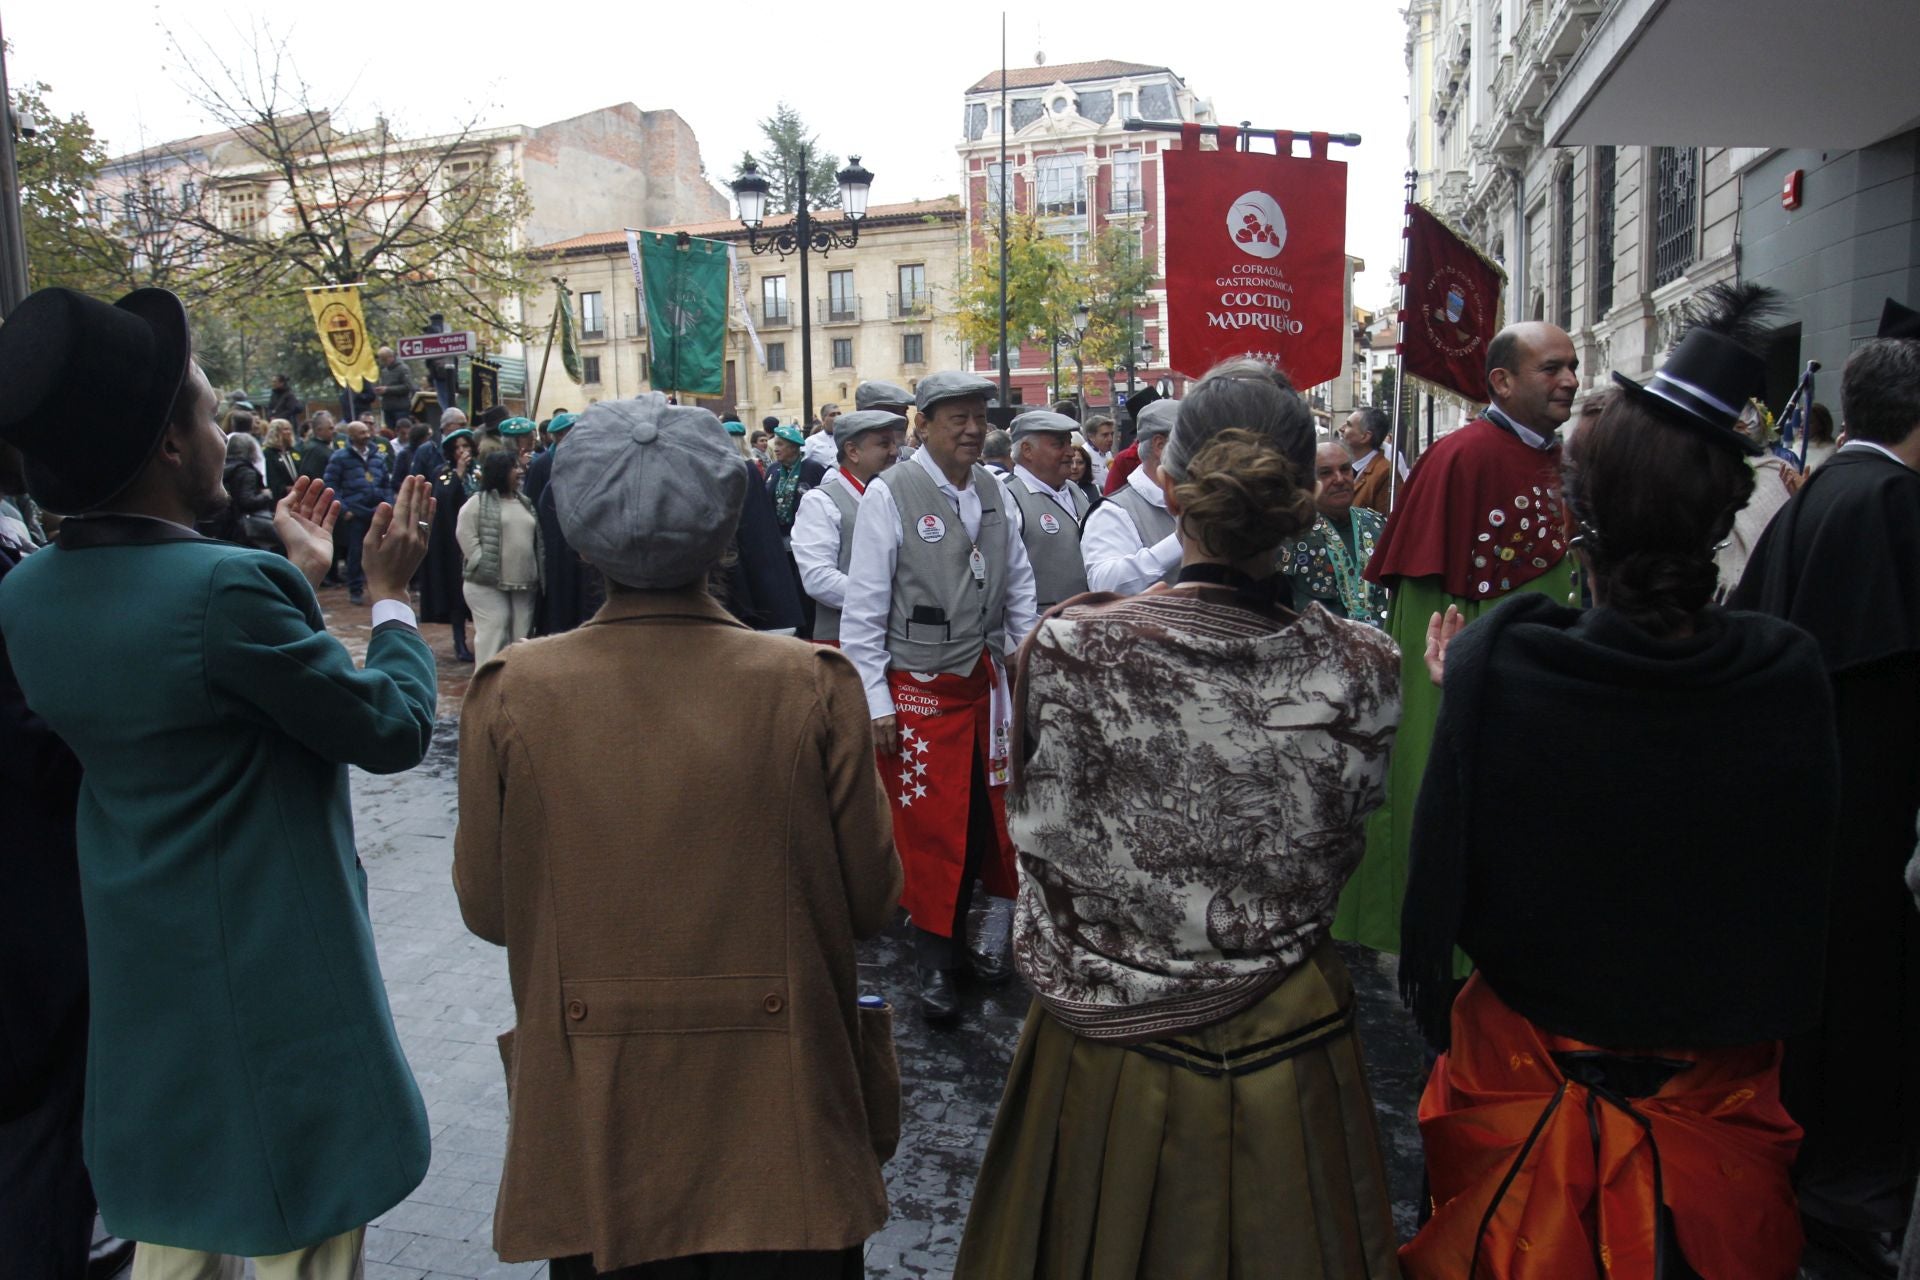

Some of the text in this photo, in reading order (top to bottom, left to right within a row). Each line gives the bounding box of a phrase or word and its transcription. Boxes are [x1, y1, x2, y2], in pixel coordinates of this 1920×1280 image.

[1232, 264, 1283, 278] COFRADÍA
[1216, 277, 1293, 294] GASTRONÓMICA
[1221, 292, 1291, 312] COCIDO
[1206, 311, 1303, 336] MADRILEÑO
[439, 335, 465, 345] Catedral
[898, 693, 939, 706] COCIDO
